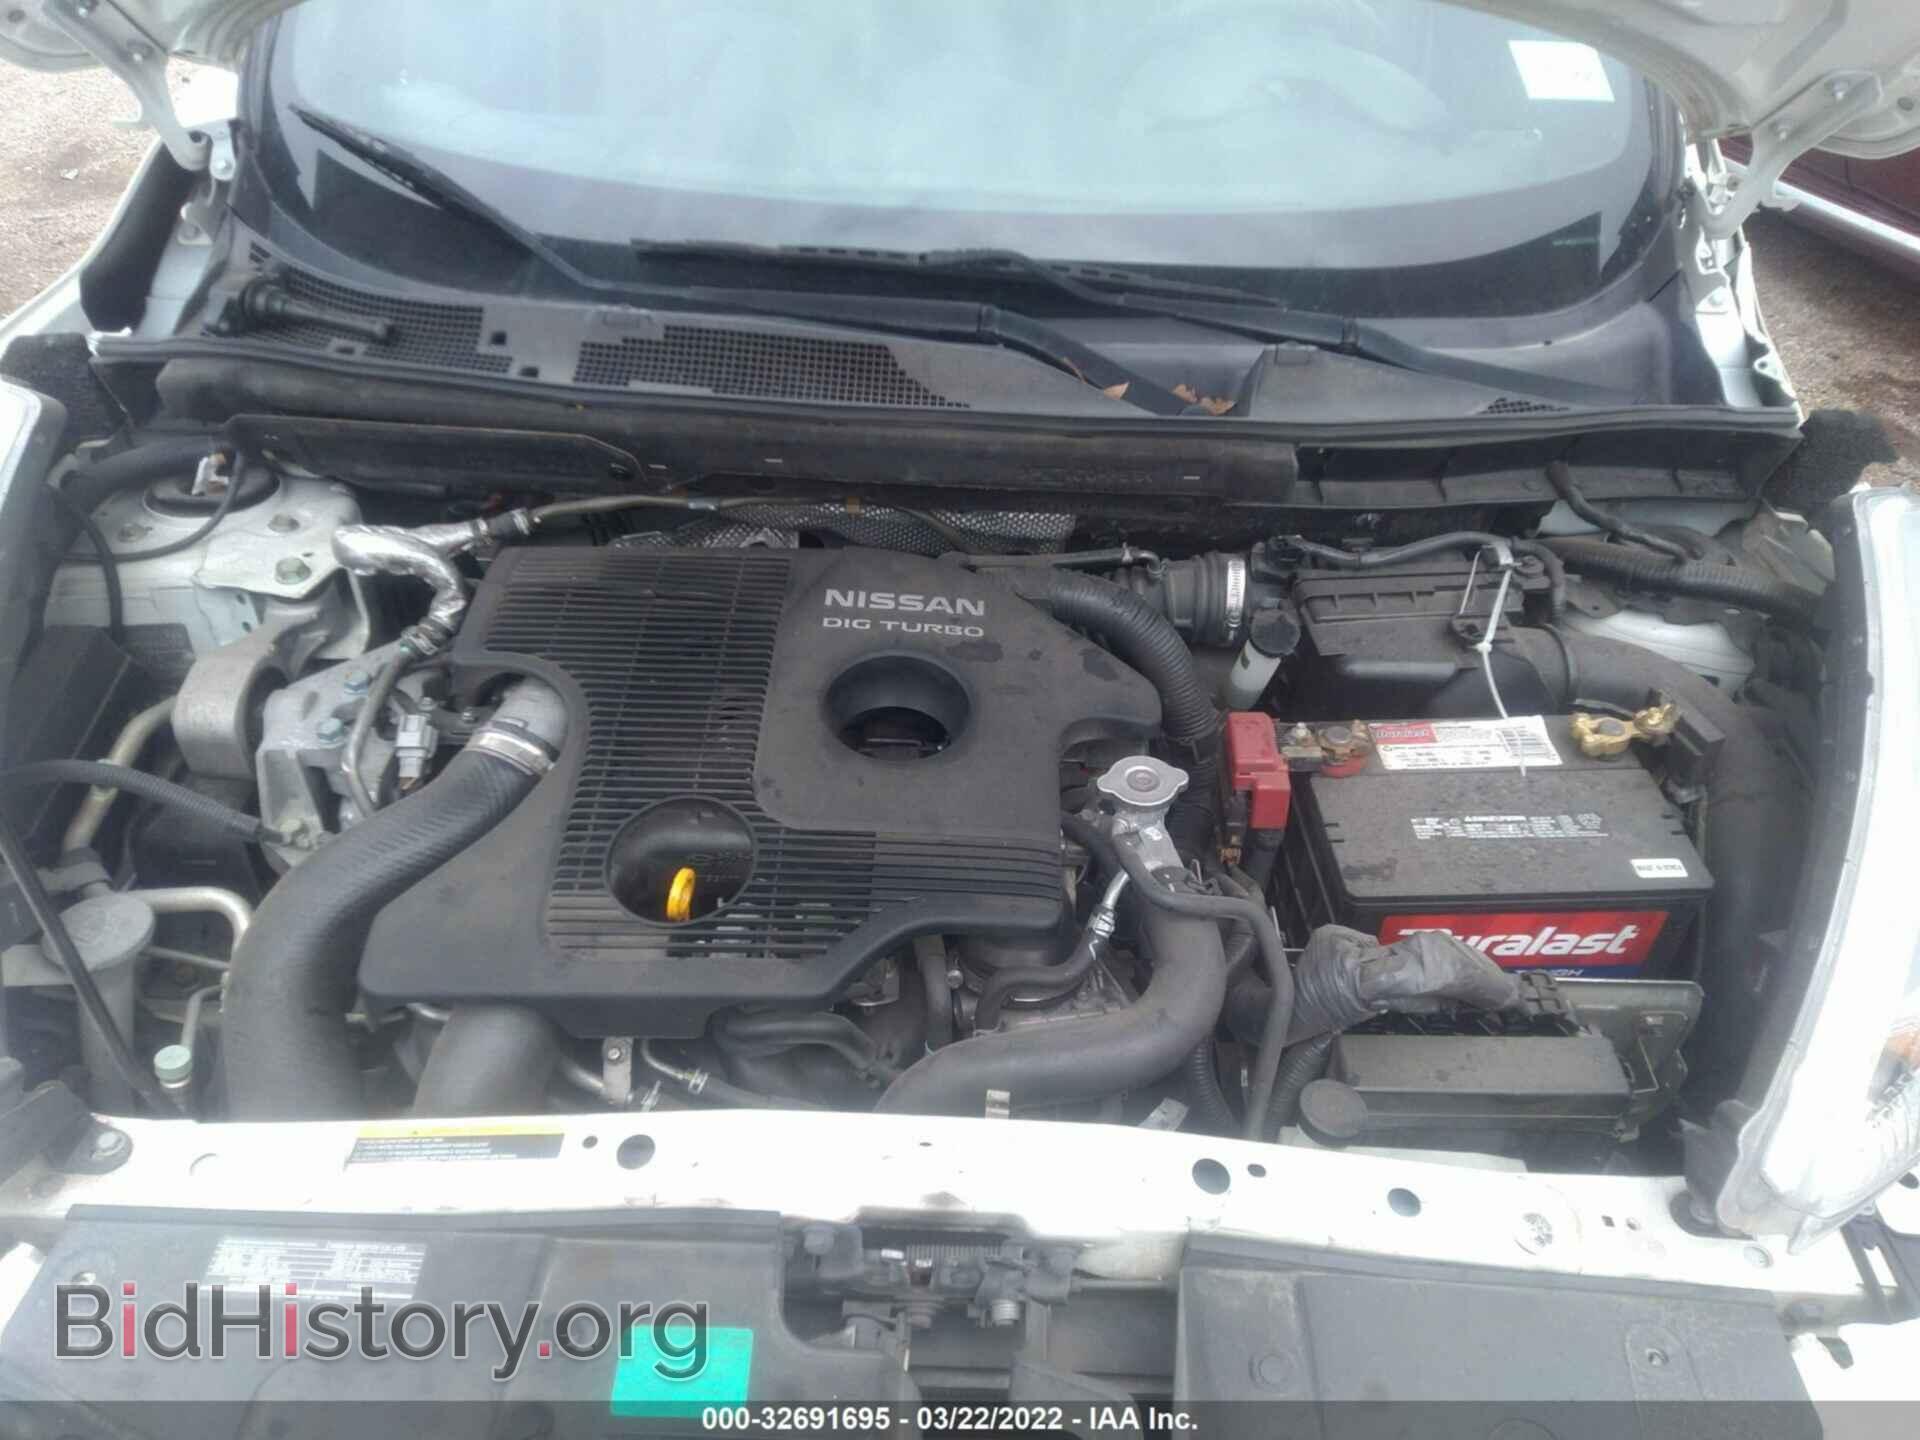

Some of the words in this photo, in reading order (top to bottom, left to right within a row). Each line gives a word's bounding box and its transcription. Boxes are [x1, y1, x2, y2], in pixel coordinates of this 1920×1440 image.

[824, 588, 985, 617] NISSAN
[822, 617, 871, 630] DIG
[879, 620, 985, 638] TURBO
[1397, 924, 1640, 956] ralast
